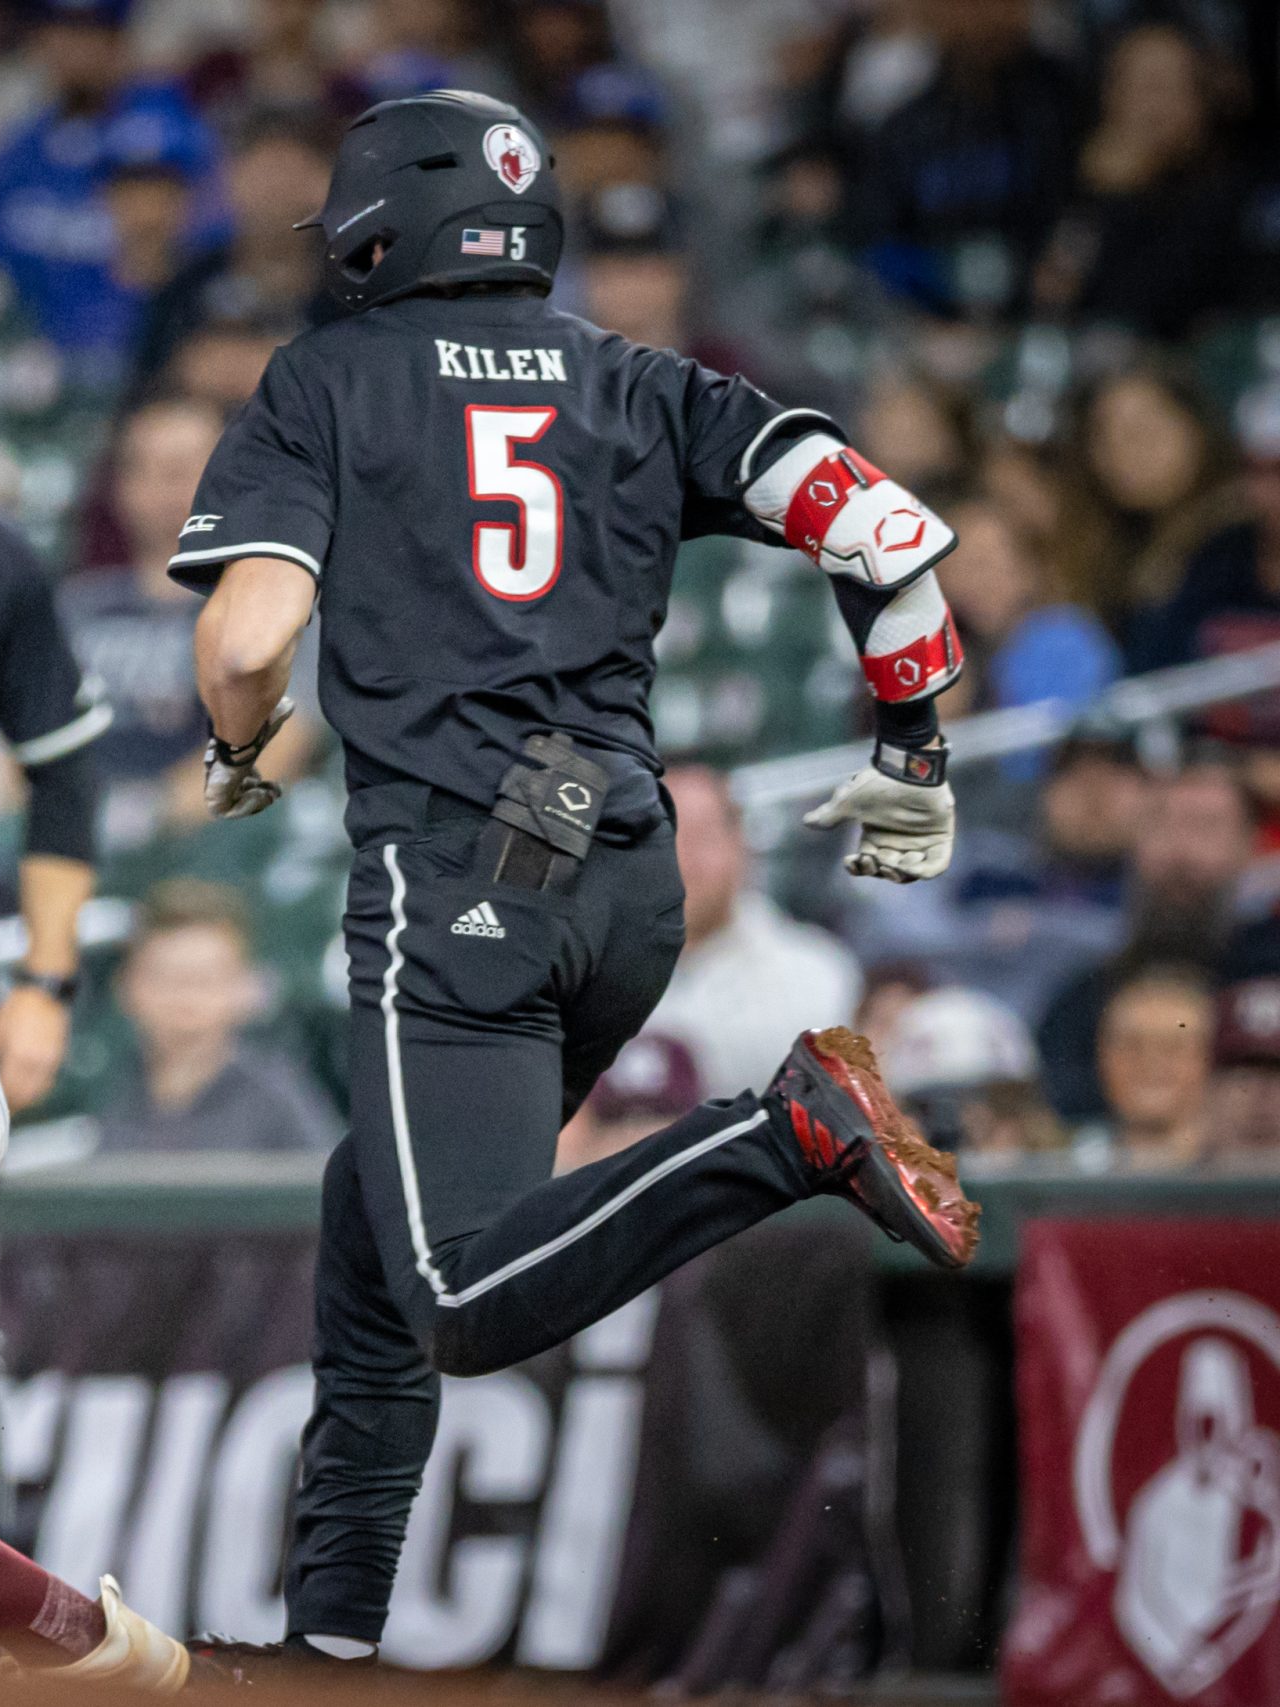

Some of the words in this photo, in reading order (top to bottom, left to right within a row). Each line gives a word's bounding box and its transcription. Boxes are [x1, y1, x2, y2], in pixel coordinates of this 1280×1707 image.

[510, 227, 527, 260] 5
[434, 339, 567, 381] KILEN
[464, 404, 564, 602] 5
[178, 514, 224, 538] CC
[450, 922, 506, 939] adidas
